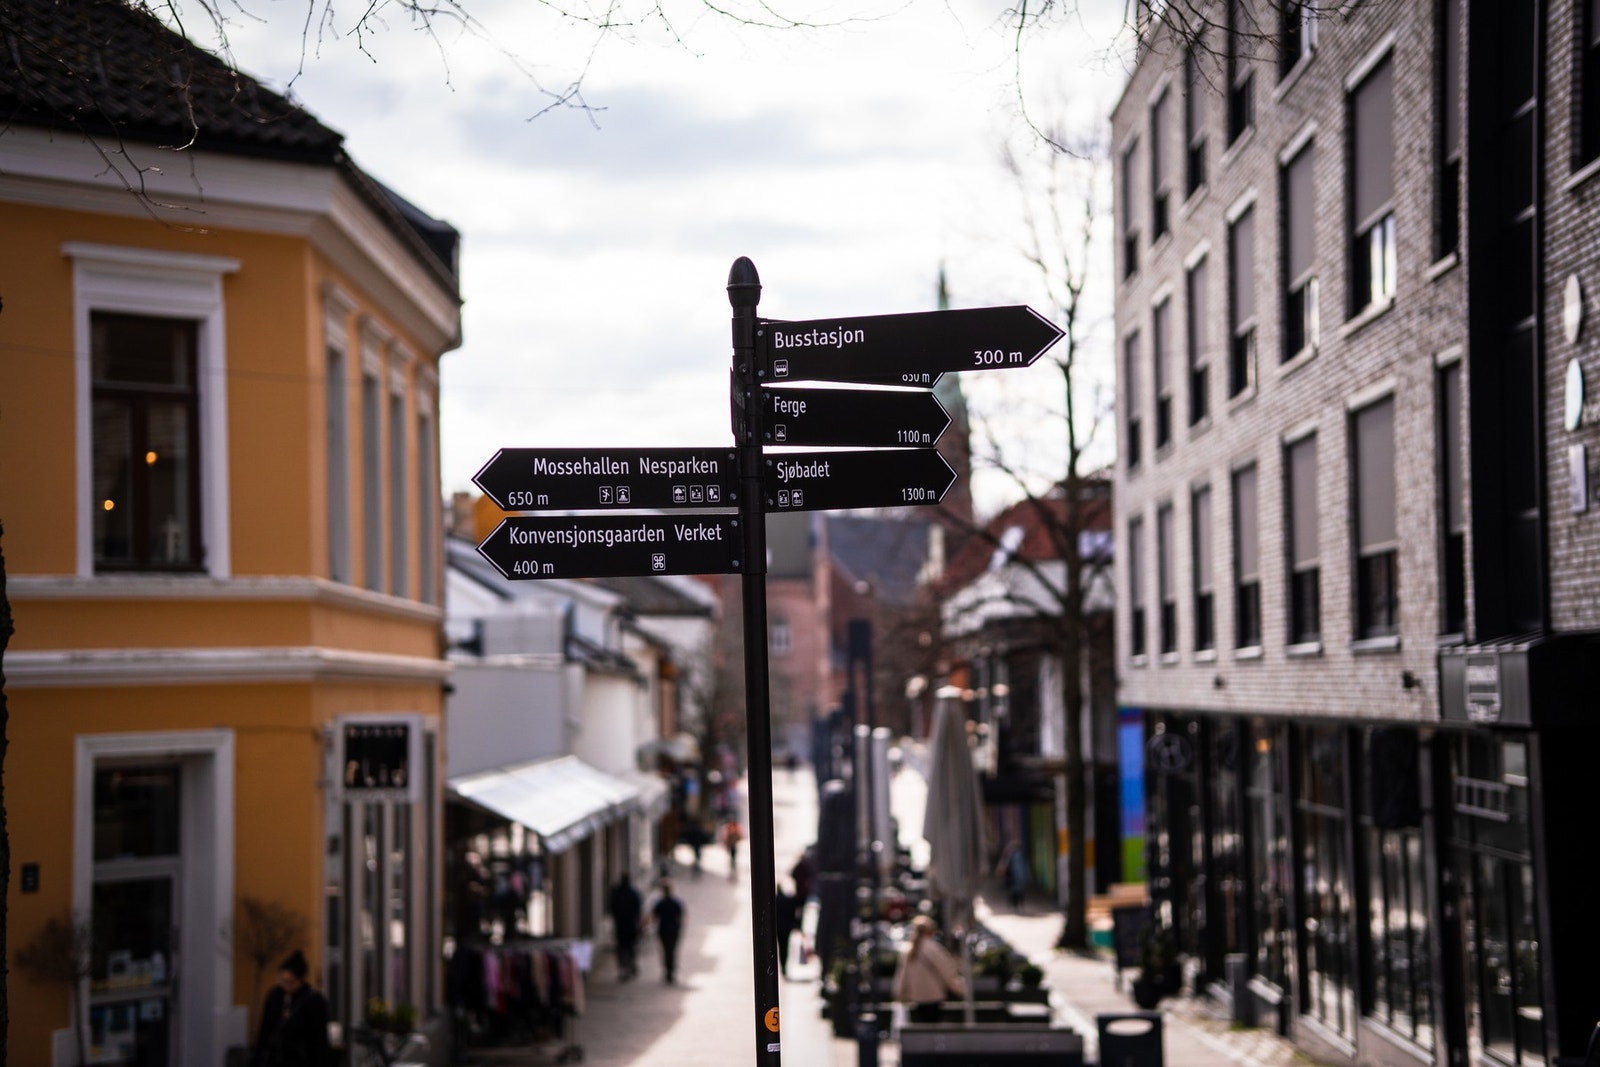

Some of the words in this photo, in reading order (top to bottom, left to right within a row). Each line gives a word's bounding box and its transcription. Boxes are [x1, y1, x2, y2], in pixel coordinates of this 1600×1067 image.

[774, 326, 865, 349] Busstasjon
[974, 350, 1003, 366] 300
[1008, 351, 1023, 363] m
[921, 373, 931, 384] m
[773, 396, 807, 417] Ferge
[897, 430, 920, 443] 1100
[922, 433, 931, 443] m
[533, 457, 630, 475] Mossehallen
[639, 457, 718, 478] Nesparken
[776, 460, 830, 483] Sjøbadet
[508, 491, 533, 506] 650
[537, 494, 549, 505] m
[901, 488, 925, 502] 1300
[926, 490, 936, 501] m
[509, 525, 665, 548] Konvensjonsgaarden
[674, 523, 723, 541] Verket
[513, 560, 539, 575] 400
[542, 563, 555, 575] m
